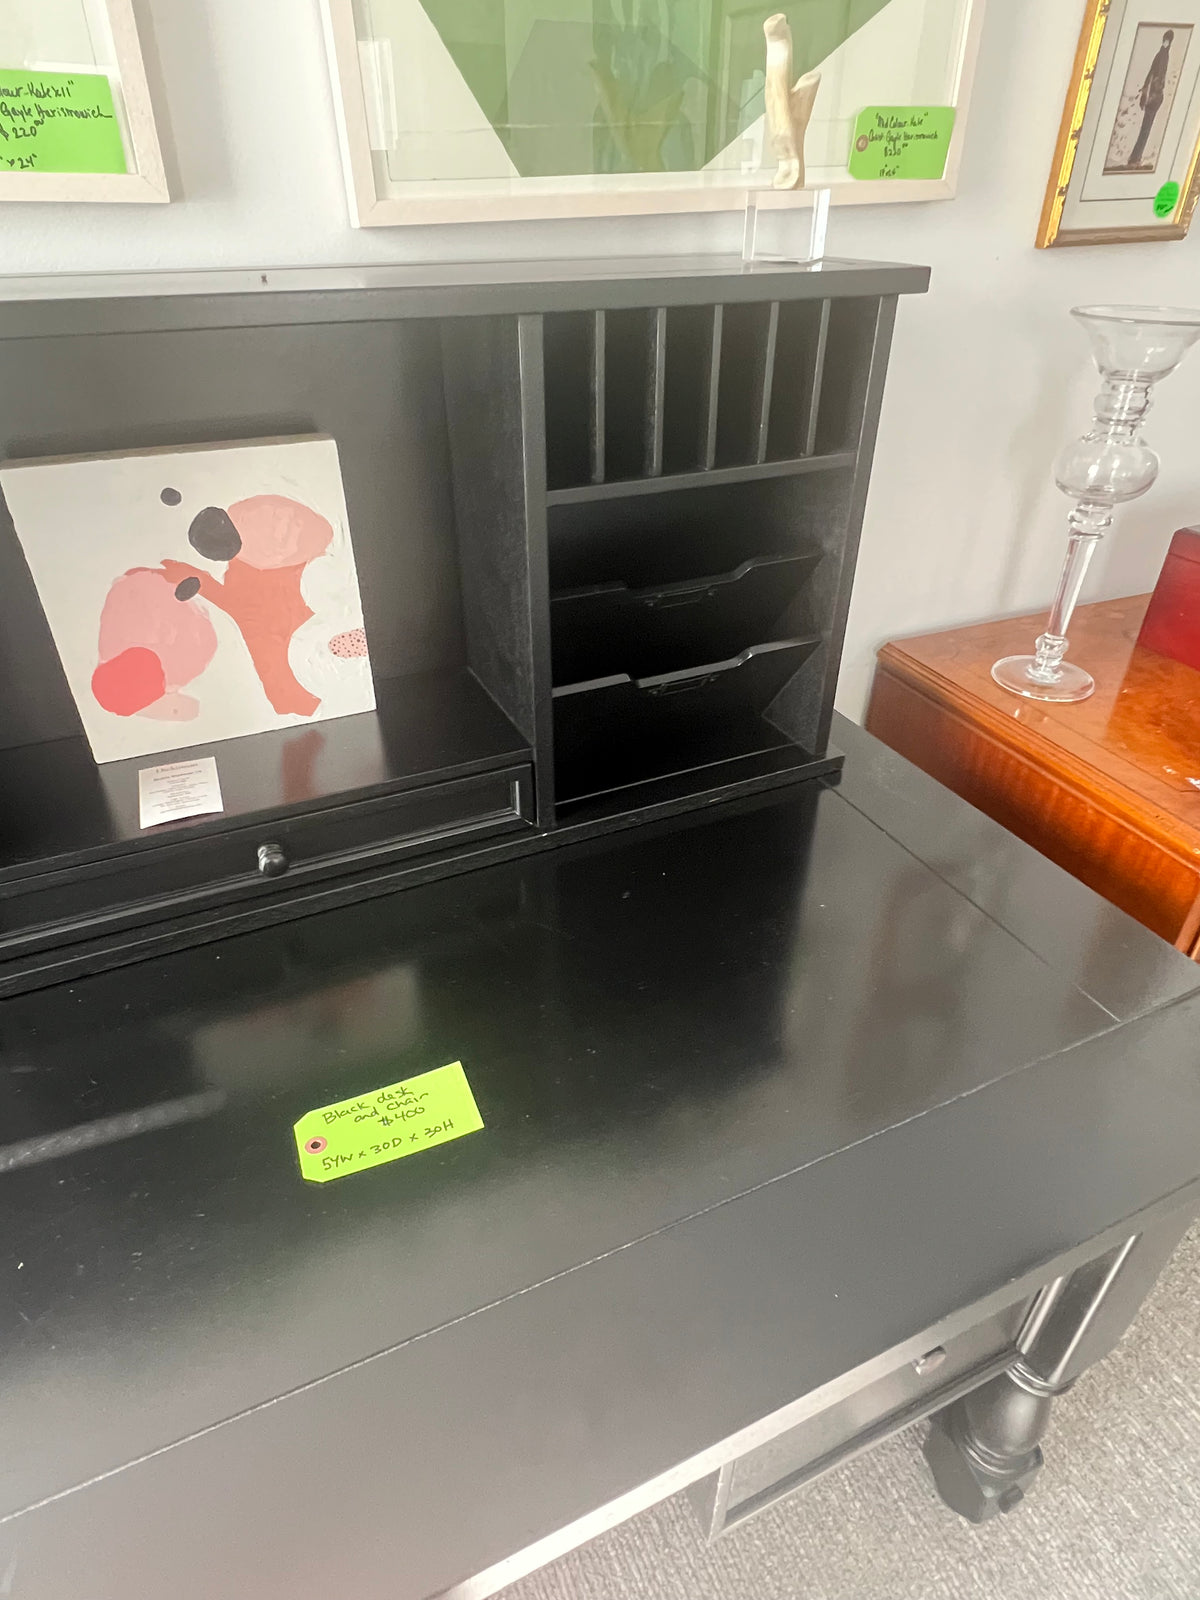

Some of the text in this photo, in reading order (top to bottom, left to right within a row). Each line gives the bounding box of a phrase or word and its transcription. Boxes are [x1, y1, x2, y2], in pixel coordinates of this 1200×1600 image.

[322, 1086, 414, 1125] Black desk
[354, 1092, 429, 1123] and chair
[378, 1106, 425, 1127] $400
[370, 1137, 402, 1154] 30D
[424, 1119, 454, 1138] 30H
